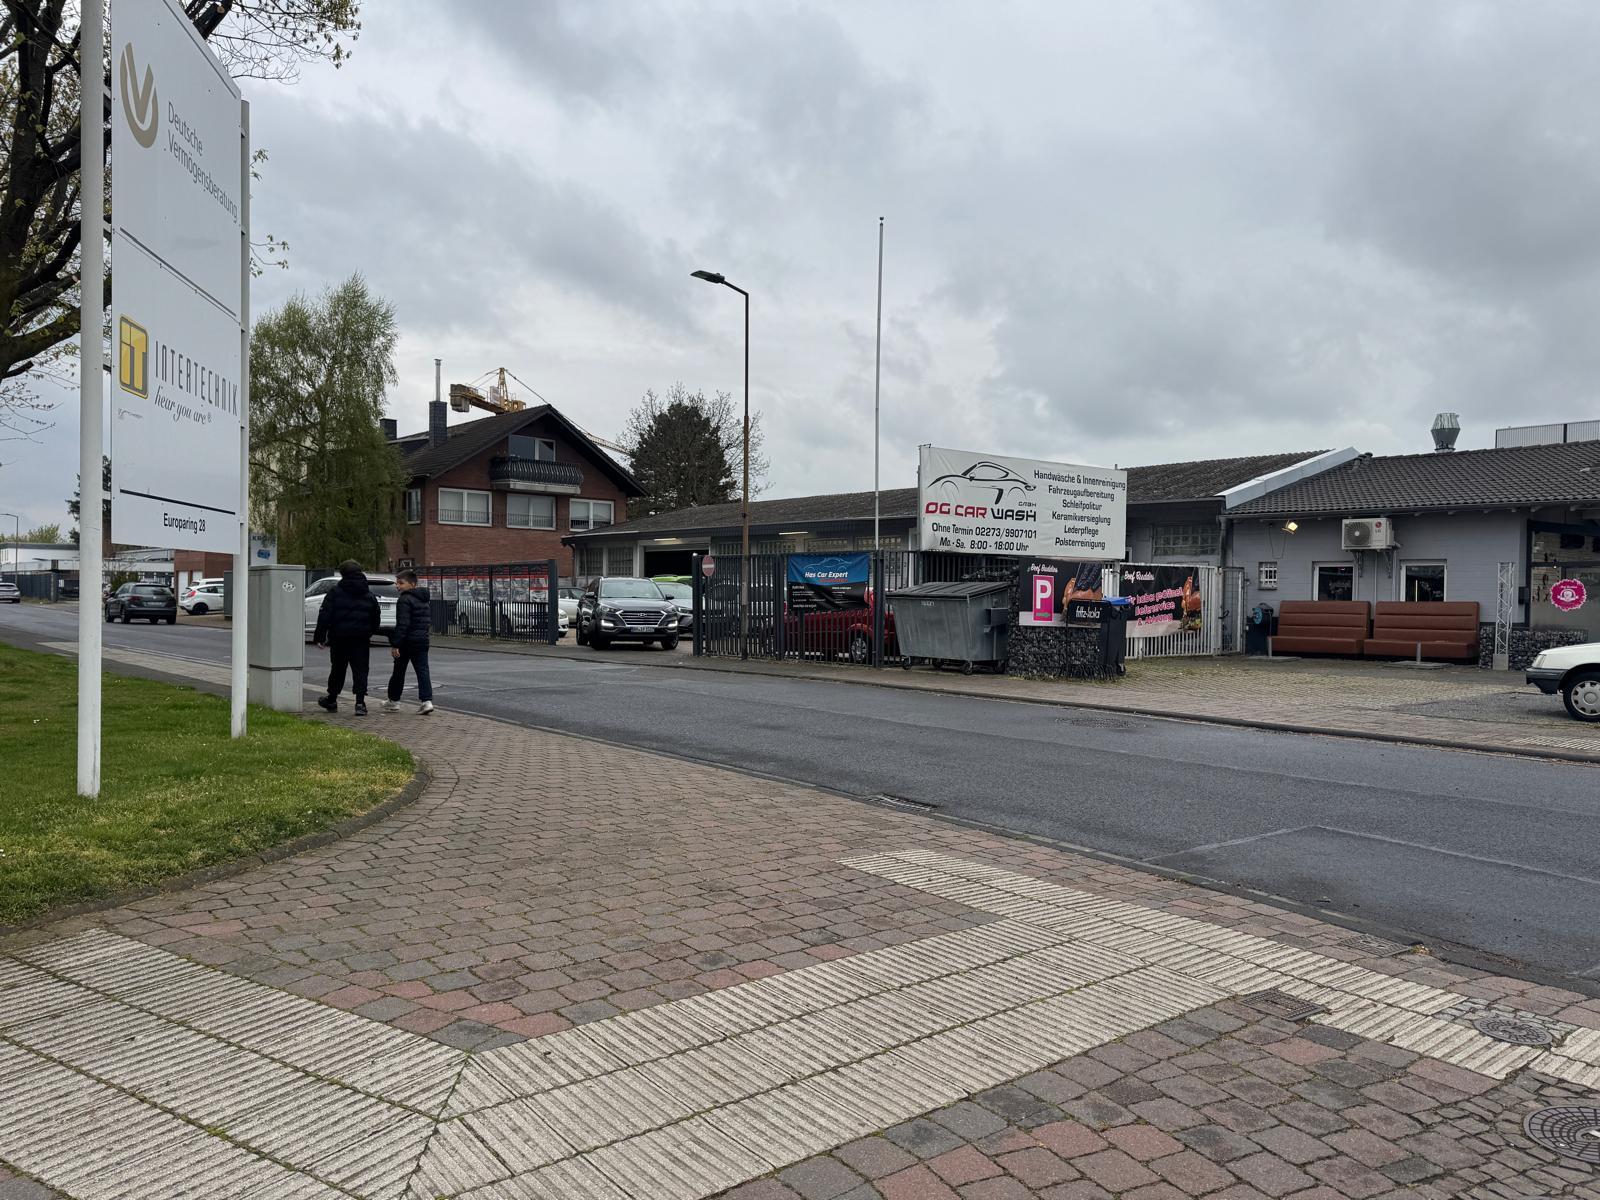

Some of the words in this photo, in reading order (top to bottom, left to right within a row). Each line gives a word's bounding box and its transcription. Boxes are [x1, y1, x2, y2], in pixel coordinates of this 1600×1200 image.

[168, 101, 203, 157] Deutsche
[168, 130, 238, 224] Vermögensberatung
[155, 340, 238, 417] INTERTECHNIK
[155, 385, 176, 412] hear
[173, 403, 192, 422] you
[1033, 469, 1075, 484] Handwäsche
[1076, 474, 1082, 484] &
[1083, 475, 1126, 491] Innenreinigung
[1048, 484, 1115, 502] Fahrzeugaufbereitung
[925, 502, 951, 515] OG
[954, 504, 988, 519] CAR
[991, 507, 1037, 522] WASH
[1062, 499, 1103, 511] Schleifpolitur
[163, 512, 198, 534] Europaring
[198, 518, 206, 532] 28
[1052, 510, 1111, 526] Keramikversieglung
[931, 522, 951, 533] Ohne
[952, 523, 974, 536] Termin
[975, 526, 1037, 540] 02273/9907101
[1064, 525, 1099, 537] Lederpflege
[970, 540, 988, 550] 8:00
[994, 541, 1014, 551] 18:00
[1016, 542, 1029, 552] Uhr
[1055, 537, 1106, 550] Polsterreinigung
[828, 571, 849, 579] Expert
[1036, 579, 1052, 610] P
